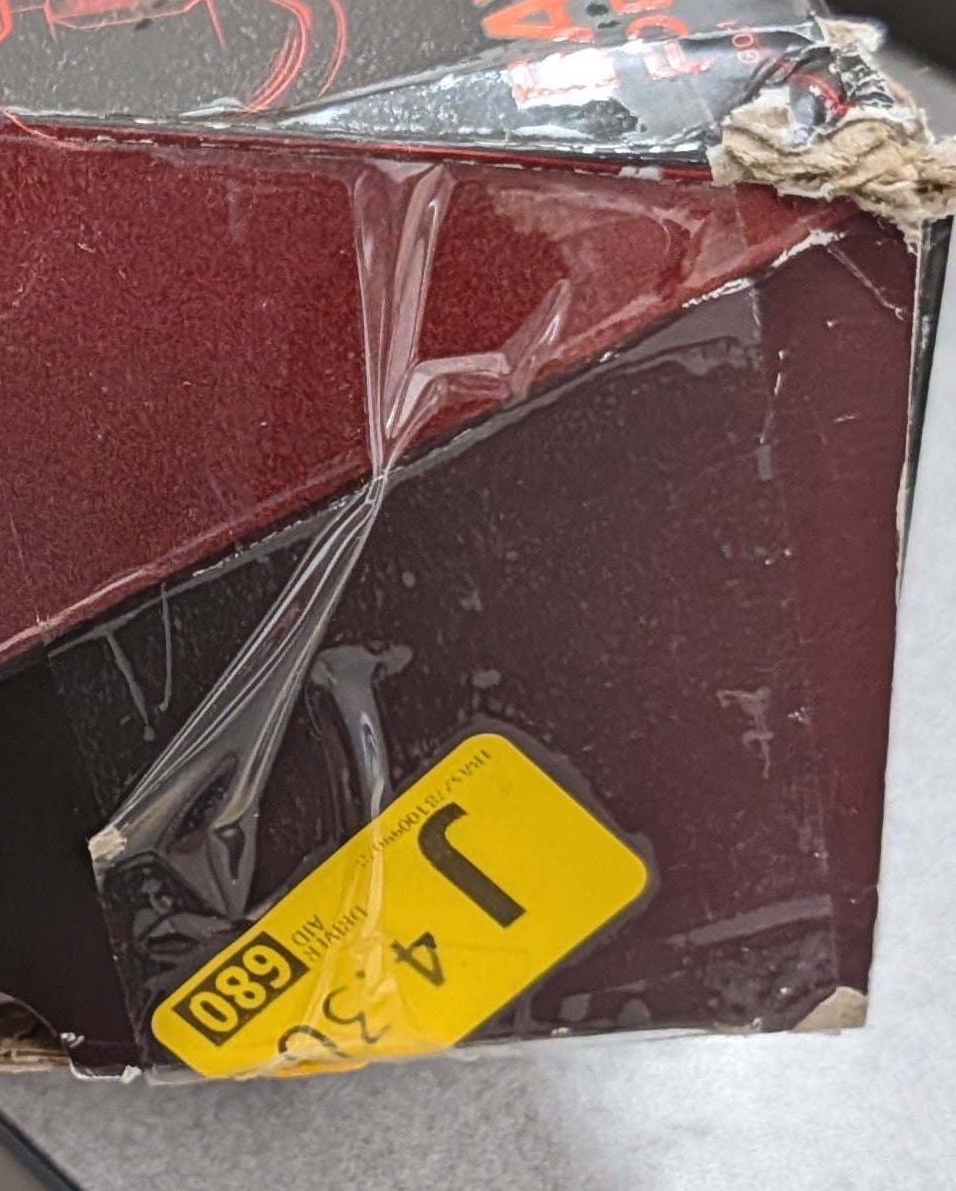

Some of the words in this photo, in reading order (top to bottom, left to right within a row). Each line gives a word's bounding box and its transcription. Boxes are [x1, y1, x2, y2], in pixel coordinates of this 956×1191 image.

[418, 802, 526, 929] J
[291, 914, 324, 946] AID
[189, 944, 292, 1034] 680
